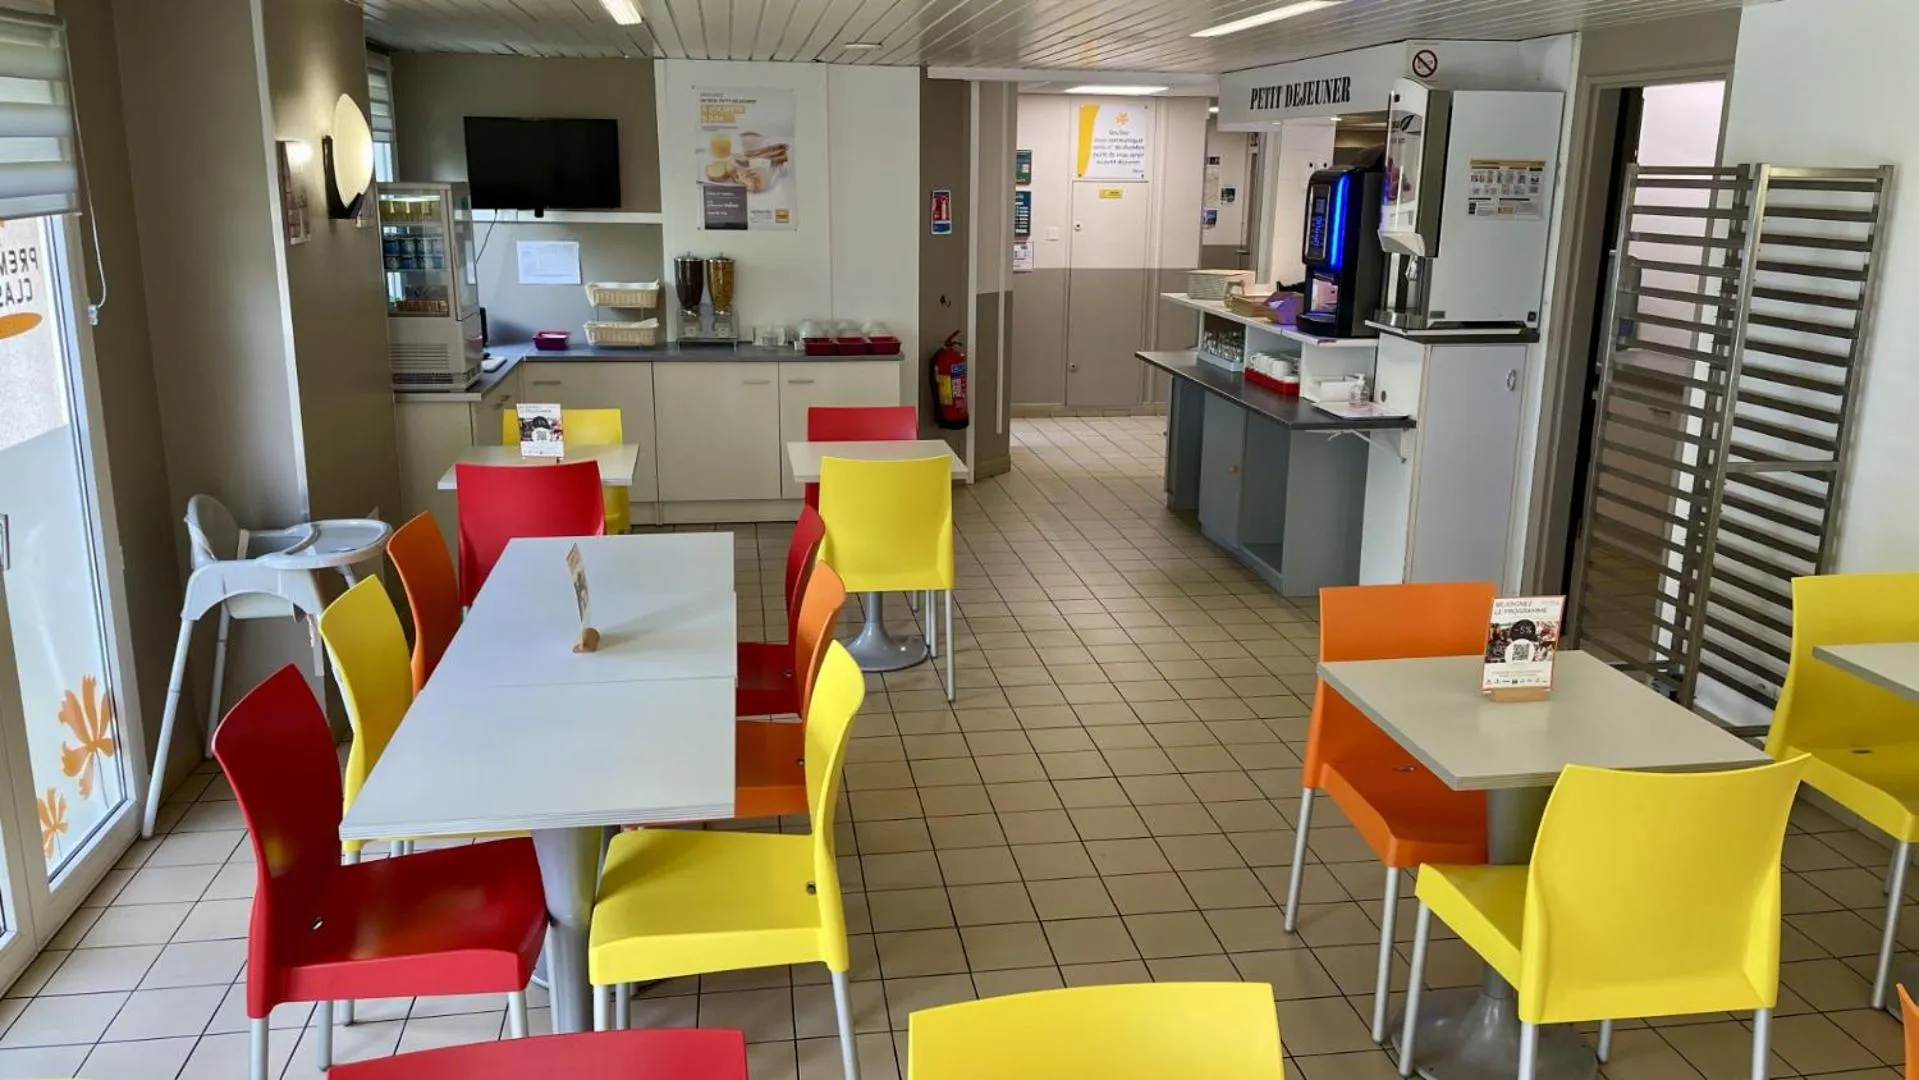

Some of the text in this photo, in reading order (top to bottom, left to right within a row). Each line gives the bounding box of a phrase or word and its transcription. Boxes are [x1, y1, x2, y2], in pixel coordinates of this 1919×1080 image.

[1250, 76, 1351, 110] PETIT DEJEUNER
[1503, 607, 1547, 615] PROGRAMME
